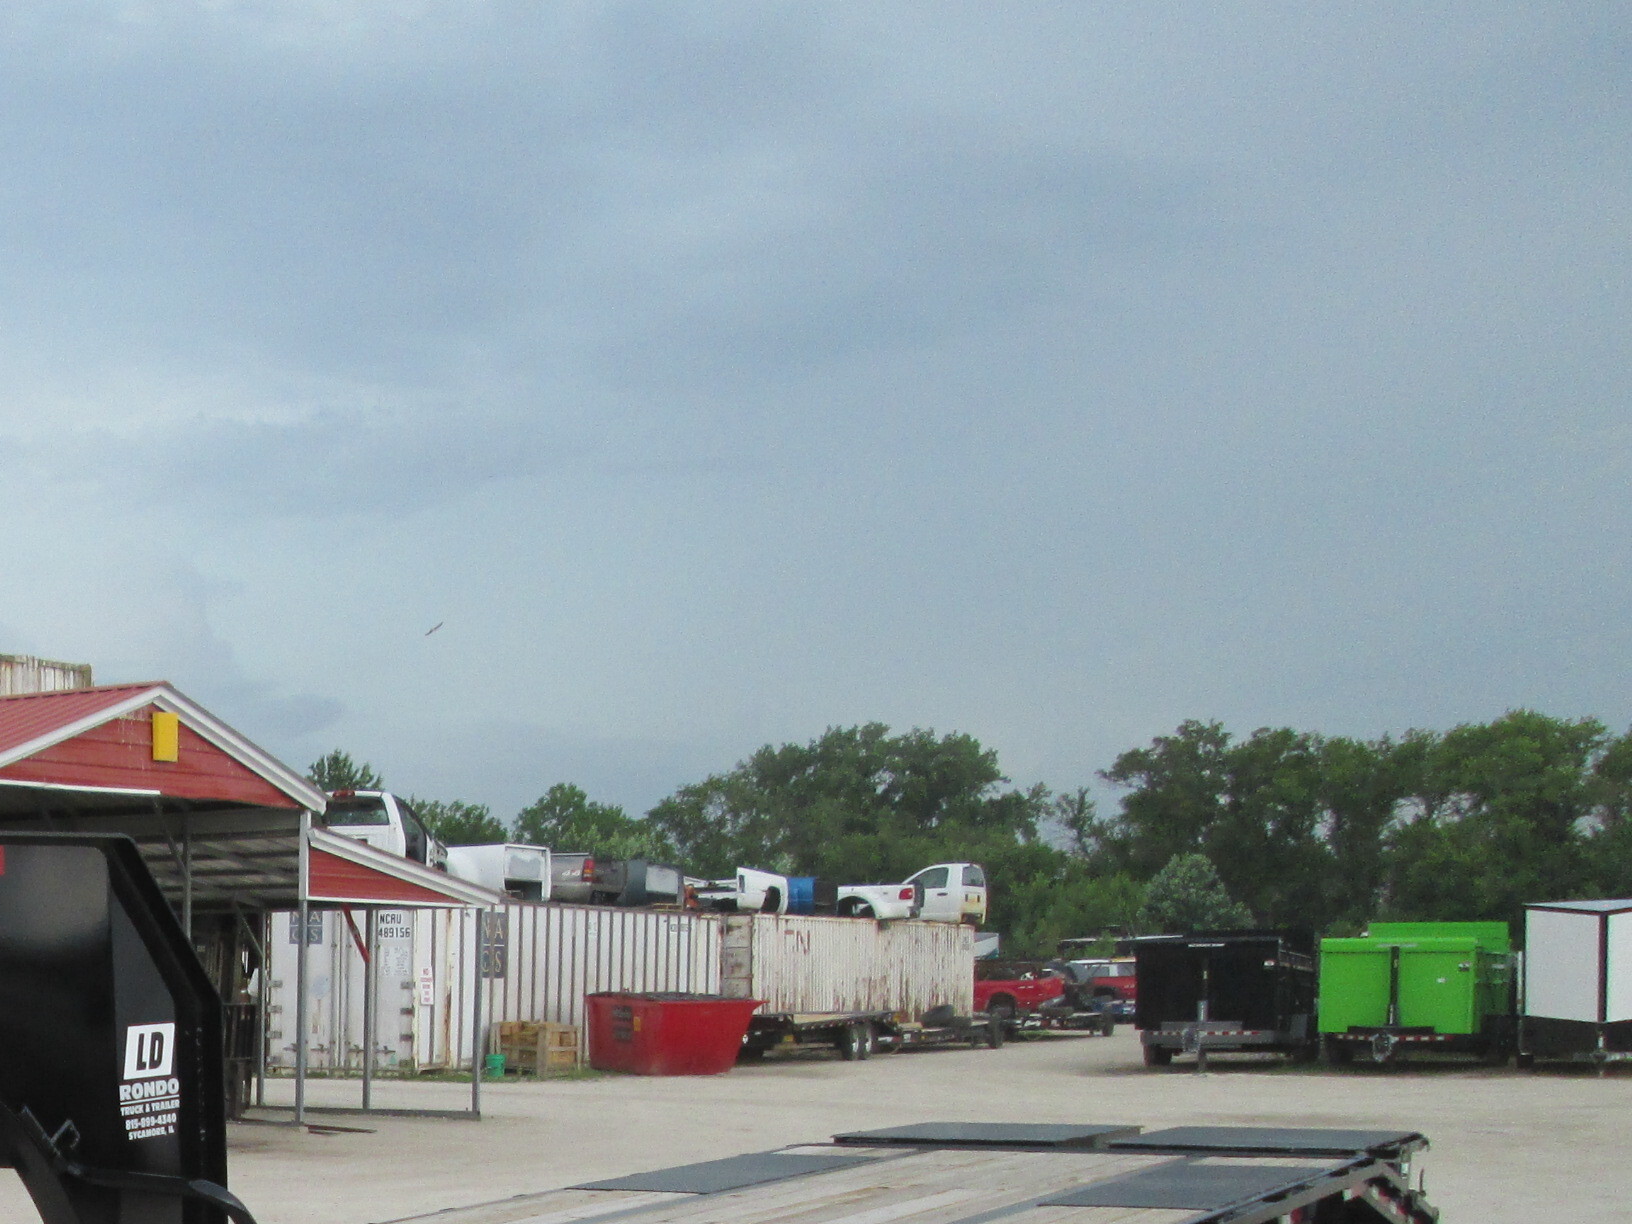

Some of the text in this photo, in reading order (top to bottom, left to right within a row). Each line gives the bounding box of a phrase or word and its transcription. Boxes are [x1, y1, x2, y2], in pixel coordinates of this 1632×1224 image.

[378, 927, 411, 938] 489156
[119, 1079, 179, 1101] RONDO
[121, 1104, 144, 1116] TRUCK
[152, 1099, 180, 1111] TRAILER
